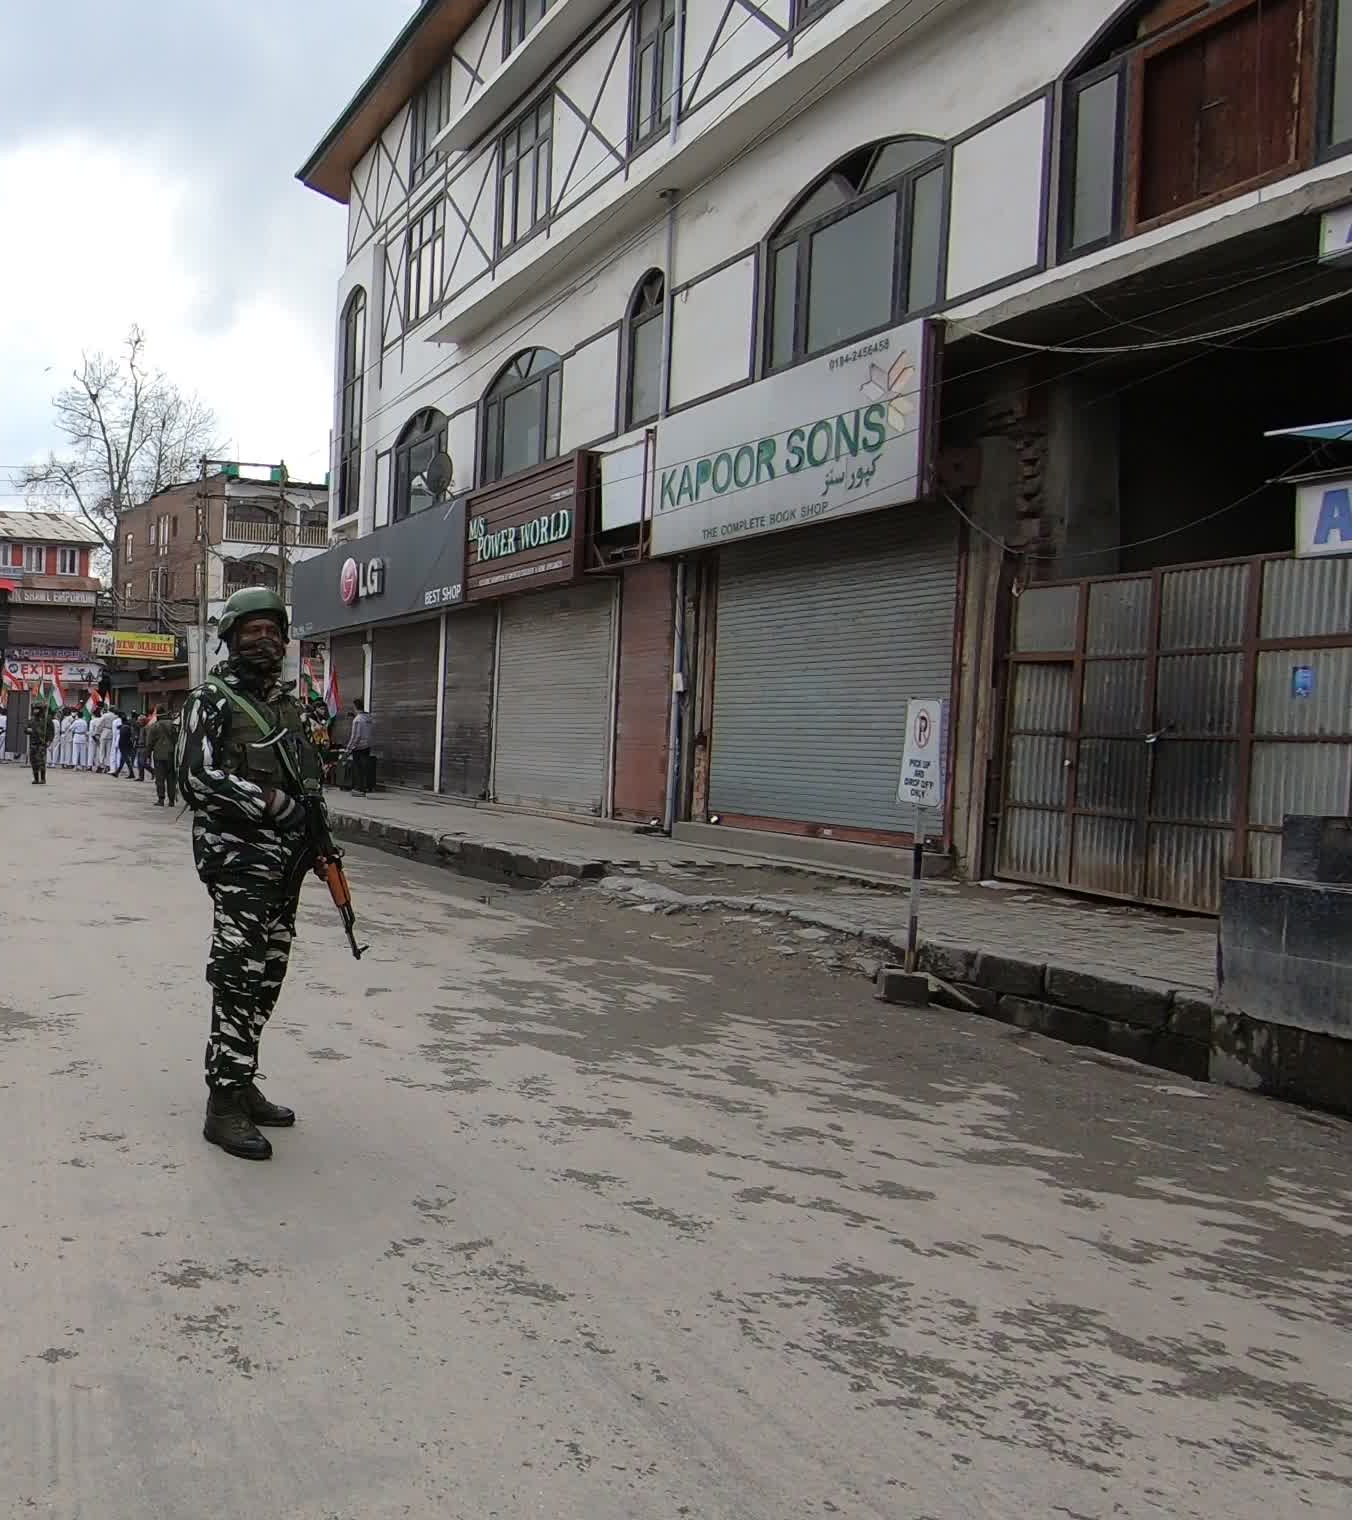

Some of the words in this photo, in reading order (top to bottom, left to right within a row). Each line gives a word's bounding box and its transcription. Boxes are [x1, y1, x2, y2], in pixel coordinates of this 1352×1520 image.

[659, 438, 776, 511] KAPOOR
[784, 403, 887, 474] SONS
[476, 526, 517, 562] POWER
[519, 508, 571, 551] WORLD
[702, 526, 718, 540] THE
[720, 516, 767, 537] COMPLETE
[769, 508, 798, 525] BOOK
[801, 501, 829, 518] SHOP
[358, 557, 386, 597] LG
[424, 588, 441, 605] BEST
[442, 583, 462, 601] SHOP
[137, 641, 173, 653] MARKET
